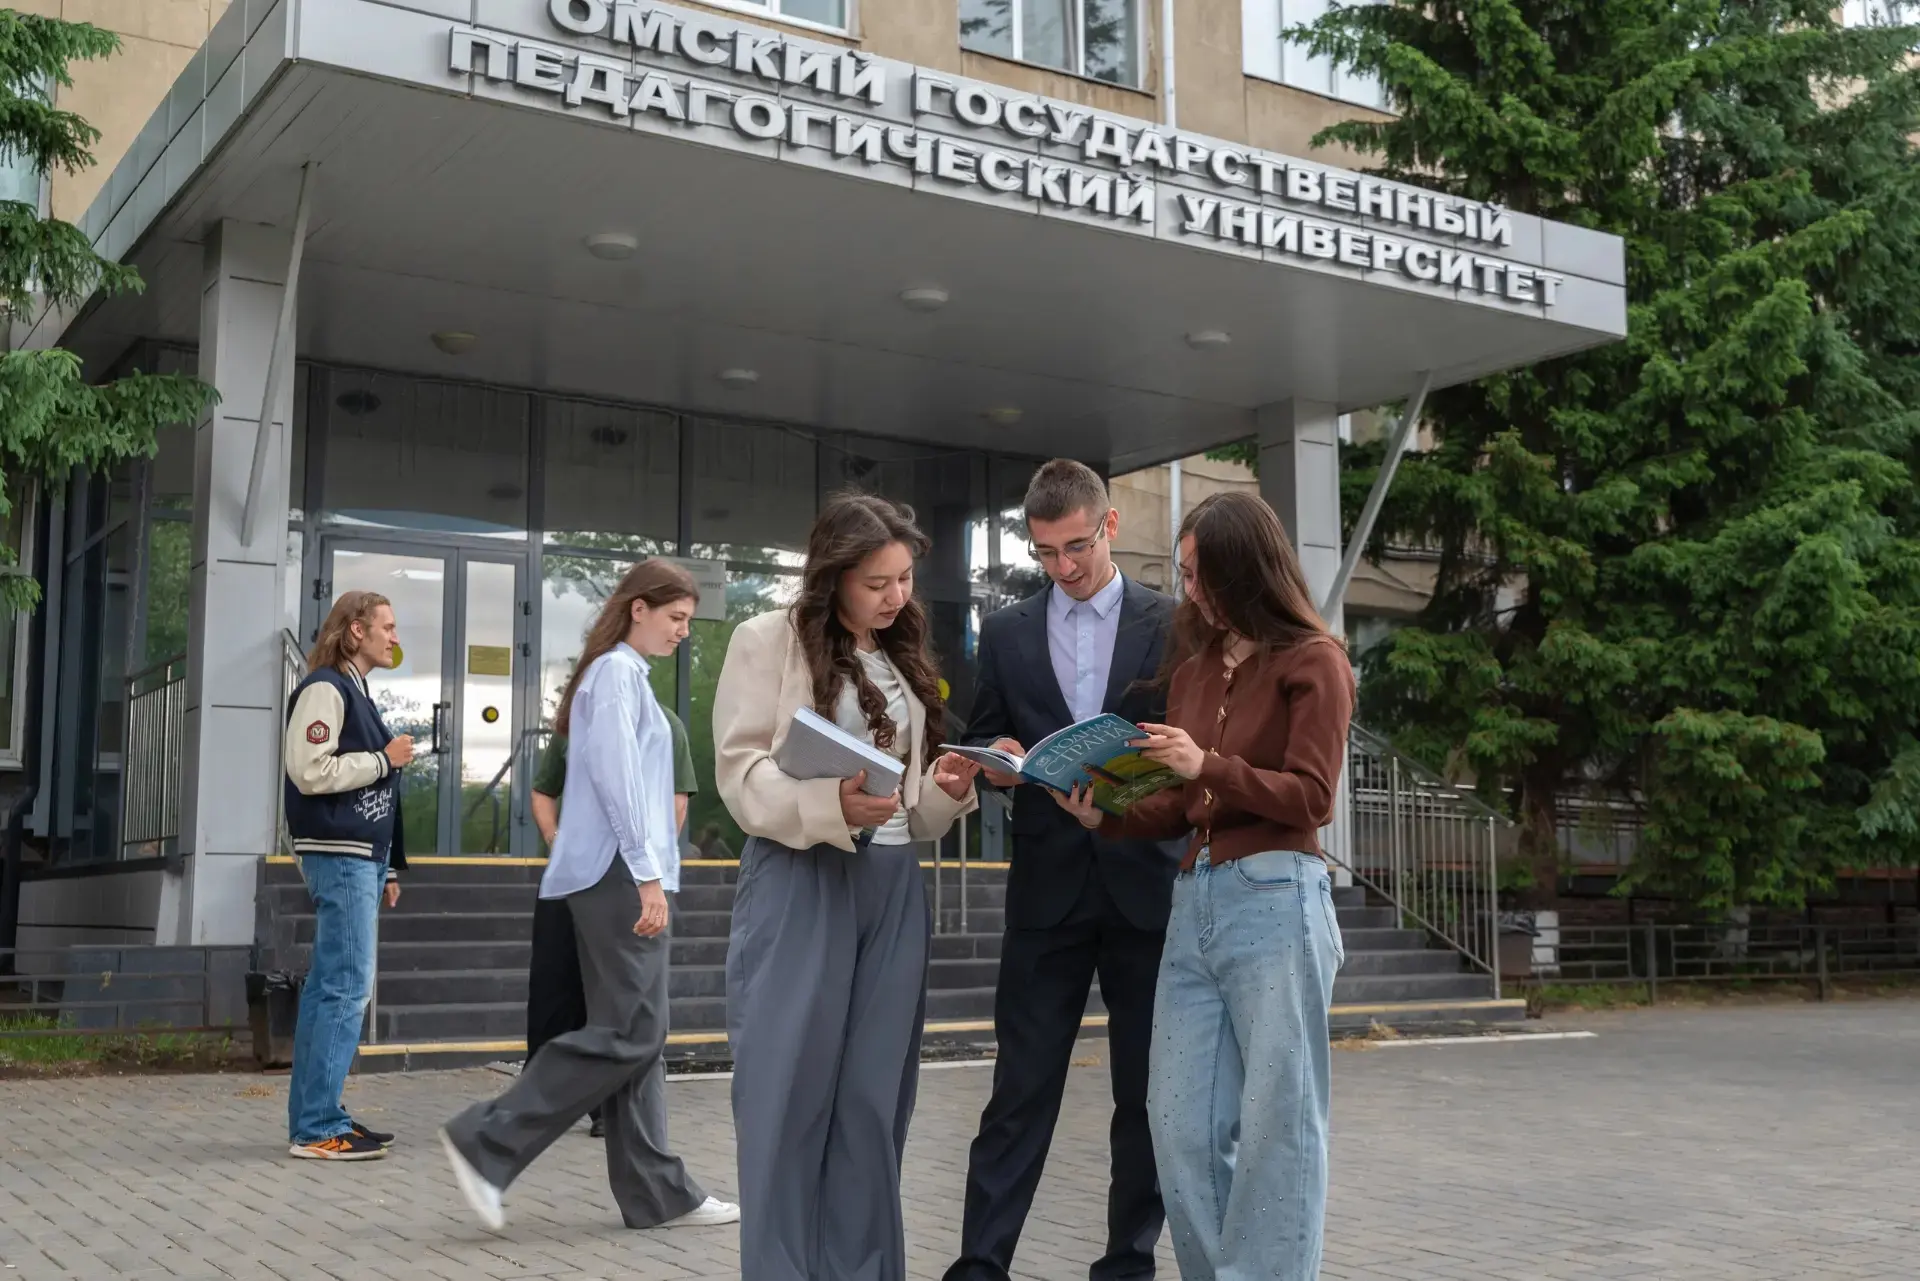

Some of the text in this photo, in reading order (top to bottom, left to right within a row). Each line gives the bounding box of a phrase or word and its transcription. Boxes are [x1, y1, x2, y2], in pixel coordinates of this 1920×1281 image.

[449, 25, 1563, 305] ПЕДАГОГИЧЕСКИЙ УНИВЕРСИТЕТ
[547, 0, 1513, 247] ОМСКИЙ ГОСУДАРСТВЕННЫЙ
[1044, 726, 1133, 776] СТРАНА
[1049, 718, 1118, 755] РОДНАЯ
